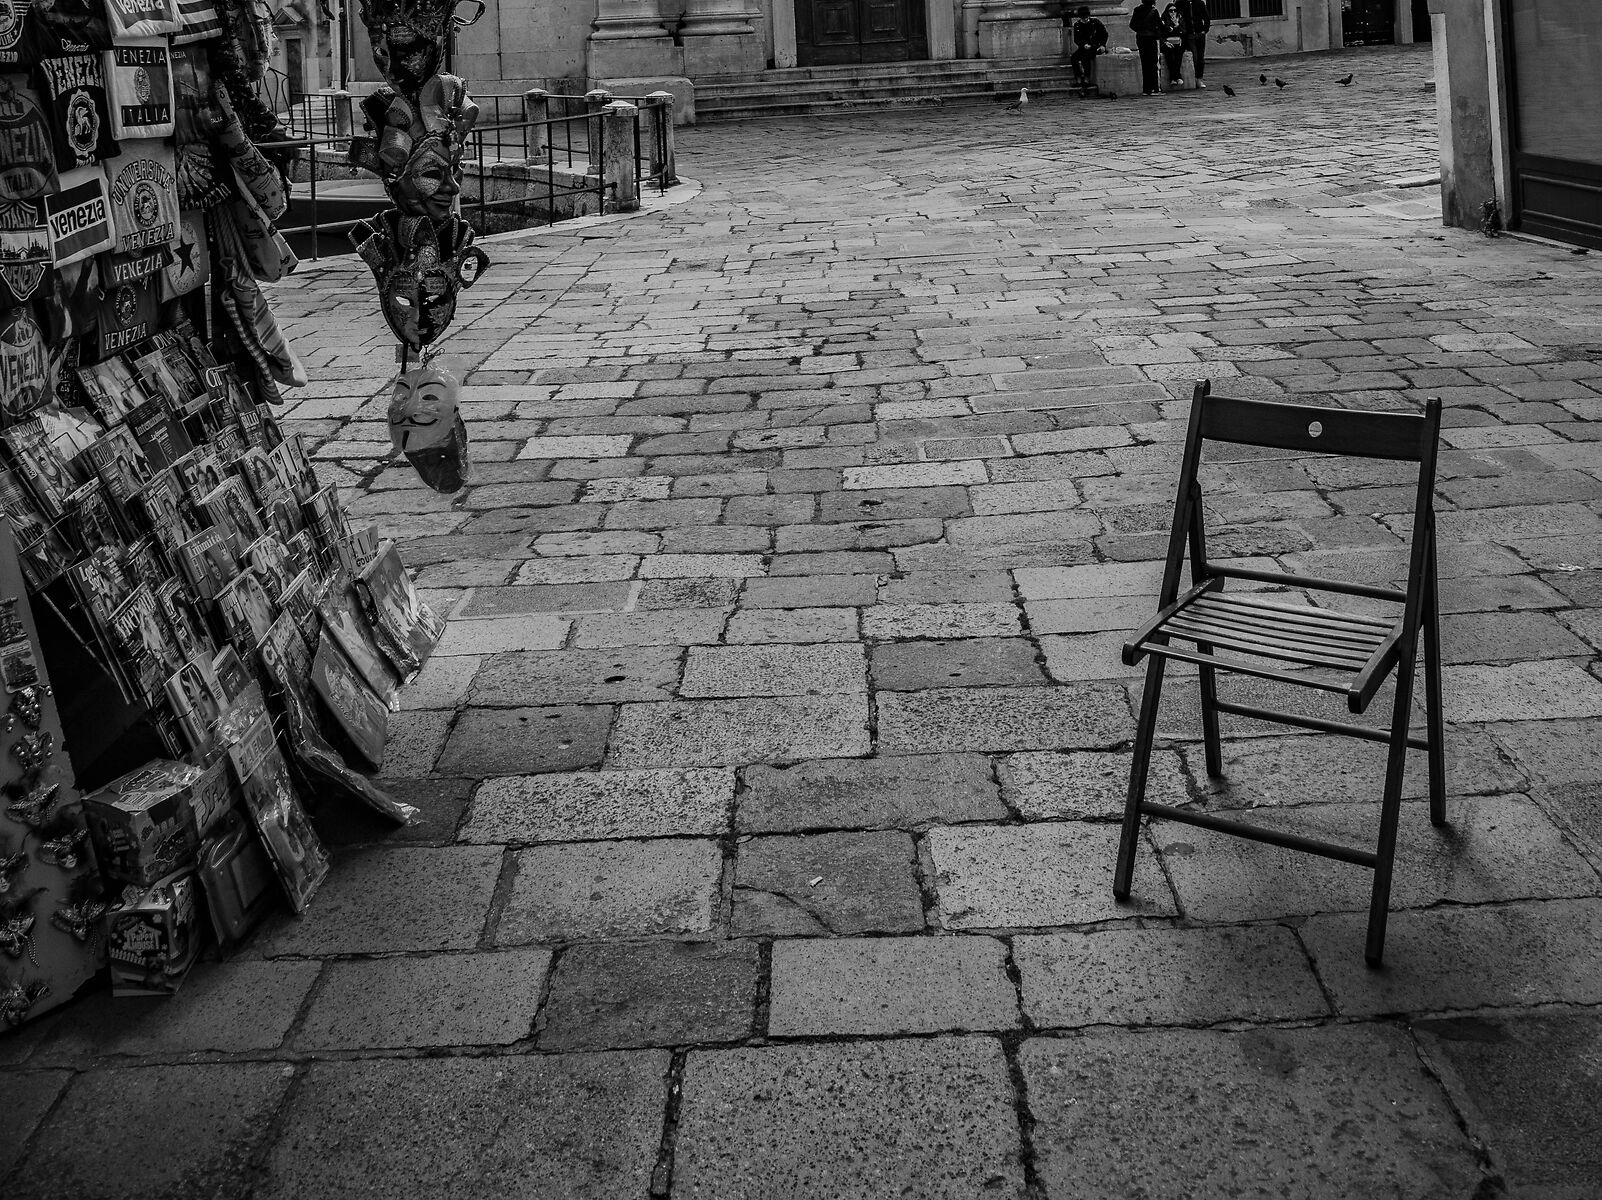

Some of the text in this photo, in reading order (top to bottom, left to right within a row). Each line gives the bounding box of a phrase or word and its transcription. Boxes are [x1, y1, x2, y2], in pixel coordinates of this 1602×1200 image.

[114, 49, 167, 65] VENEZIA
[121, 107, 170, 126] ITALIA
[50, 199, 106, 240] venezia
[122, 222, 175, 252] VENEZIA
[114, 252, 163, 282] VENEZIA
[104, 321, 147, 350] VENEZIA
